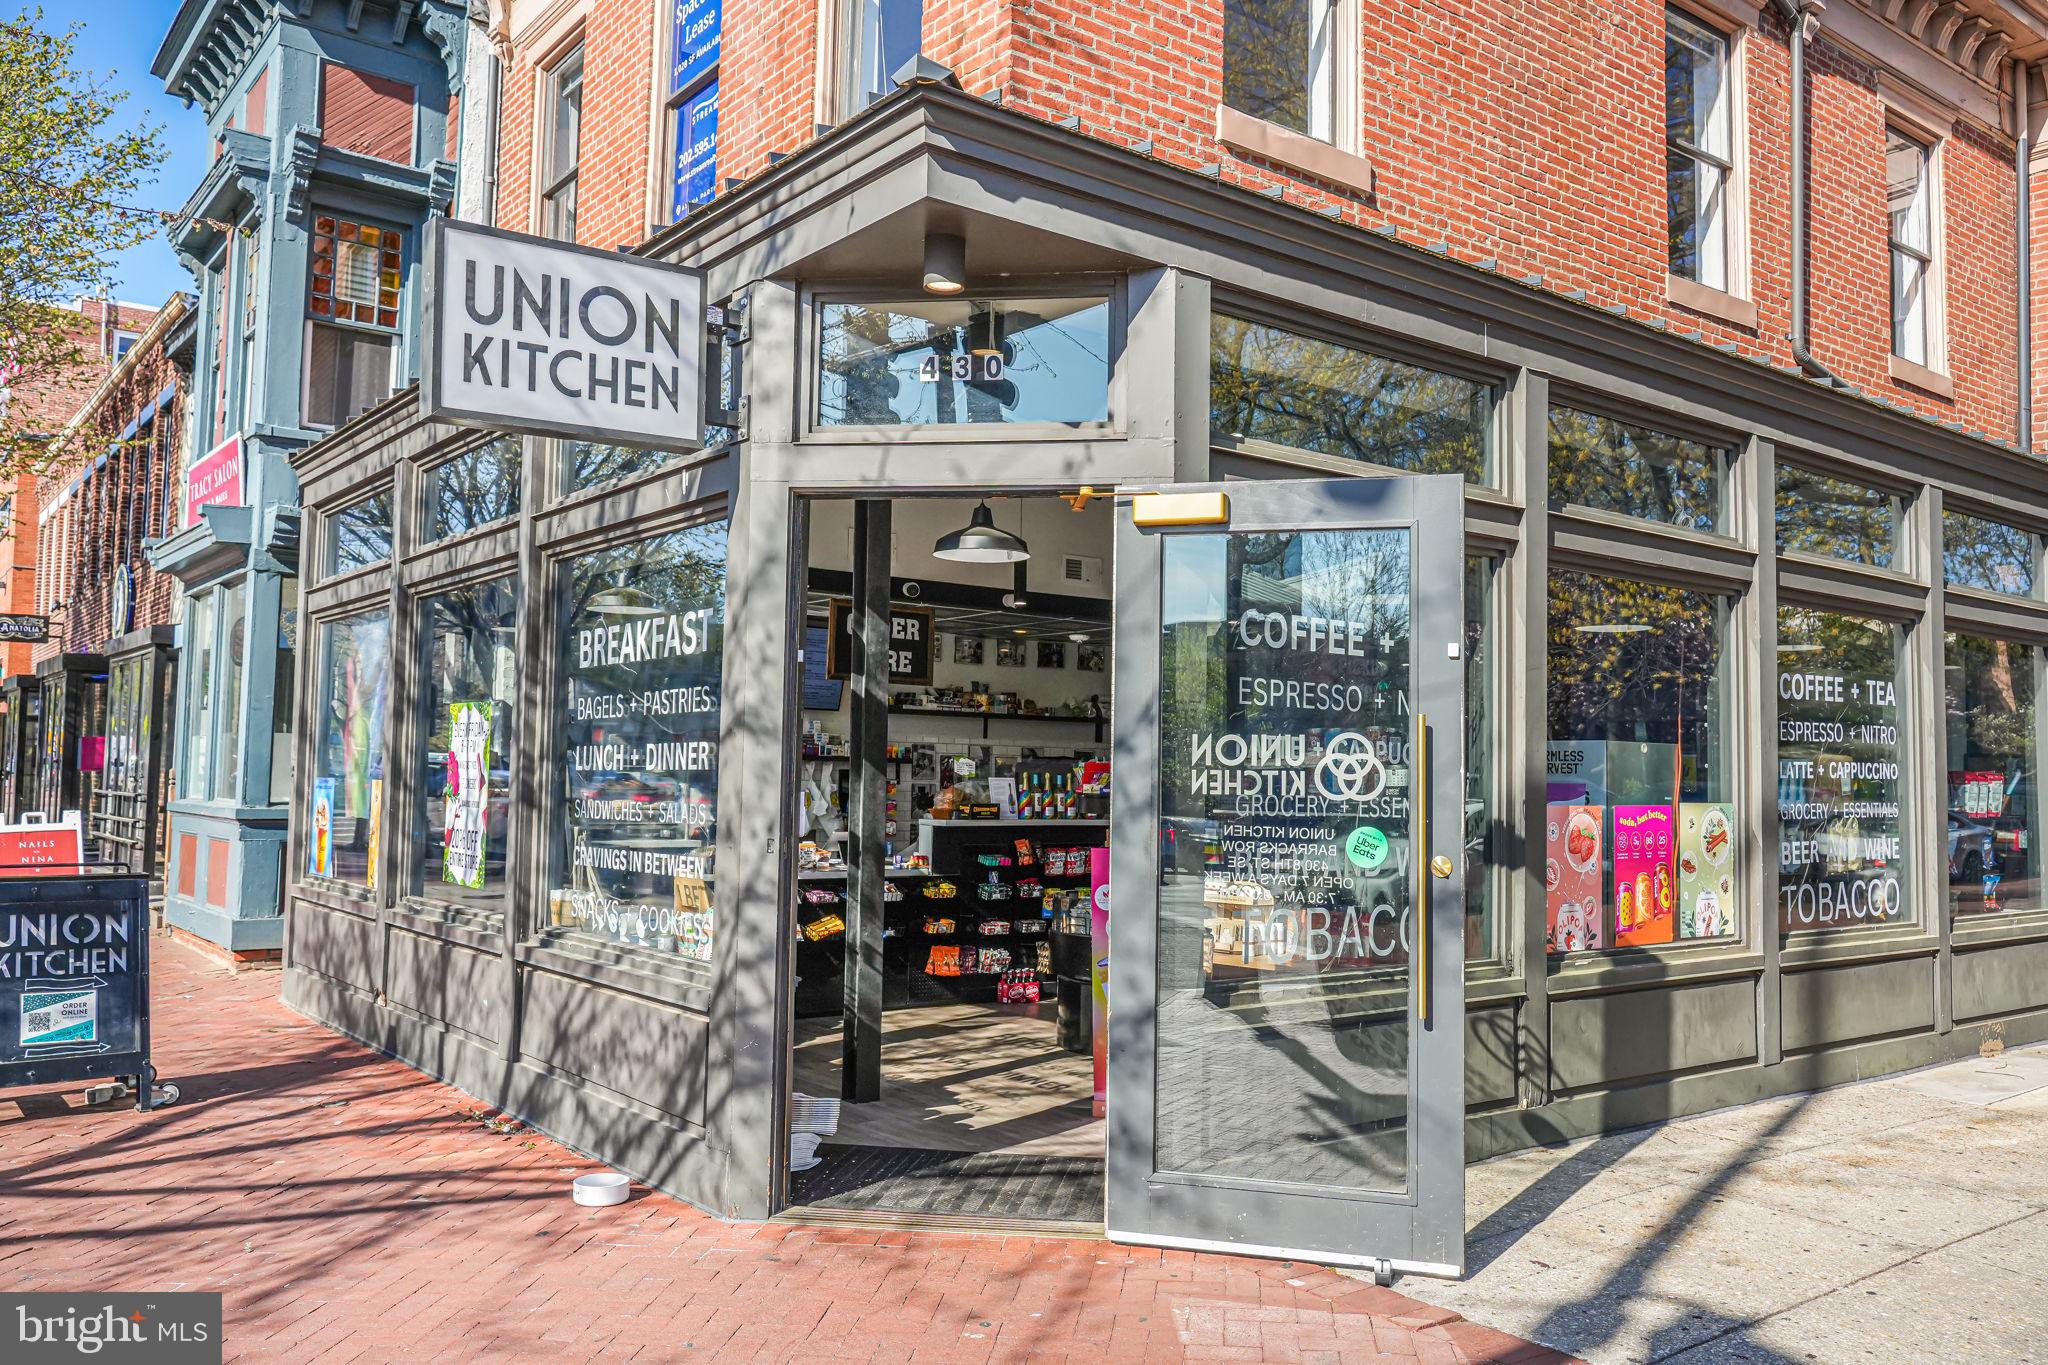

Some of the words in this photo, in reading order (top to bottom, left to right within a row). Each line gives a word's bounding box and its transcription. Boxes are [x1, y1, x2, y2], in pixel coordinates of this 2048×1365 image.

[685, 9, 716, 45] Lease
[465, 259, 680, 360] UNION
[463, 332, 679, 414] KITCHEN
[190, 473, 212, 502] TRACY
[214, 456, 238, 488] SALON
[1, 622, 40, 633] ANATOLIA
[579, 608, 714, 669] BREAKFAST
[1240, 608, 1364, 657] COFFEE
[578, 694, 624, 720] BAGELS
[643, 686, 710, 716] PASTRIES
[1239, 677, 1362, 713] ESPRESSO
[1780, 673, 1844, 703] COFFEE
[1866, 680, 1896, 706] TEA
[1780, 721, 1844, 742] ESPRESSO
[1861, 724, 1897, 745] NITRO
[575, 744, 624, 771] LUNCH
[645, 741, 709, 771] DINNER
[1780, 762, 1814, 779] LATTE
[1829, 761, 1898, 780] CAPPUCCINO
[574, 799, 643, 822] SANDWICHES
[659, 803, 706, 825] SALADS
[1235, 794, 1329, 817] GROCERY
[1636, 813, 1649, 825] but
[1647, 809, 1667, 822] better
[1781, 803, 1829, 820] GROCERY
[1843, 802, 1899, 818] ESSENTIALS
[18, 840, 56, 848] NAILS
[1352, 844, 1376, 860] Eats
[1356, 836, 1380, 851] Uber
[1781, 840, 1820, 866] BEER
[1826, 837, 1858, 862] AND
[1864, 837, 1900, 860] WINE
[573, 846, 627, 871] CRAVINGS
[630, 851, 642, 872] IN
[644, 854, 704, 880] BETWEEN
[571, 894, 620, 923] SNACKS
[1781, 878, 1900, 924] TOBACCO
[0, 913, 128, 948] UNION
[0, 947, 127, 978] KITCHEN
[61, 1008, 88, 1016] ONLINE
